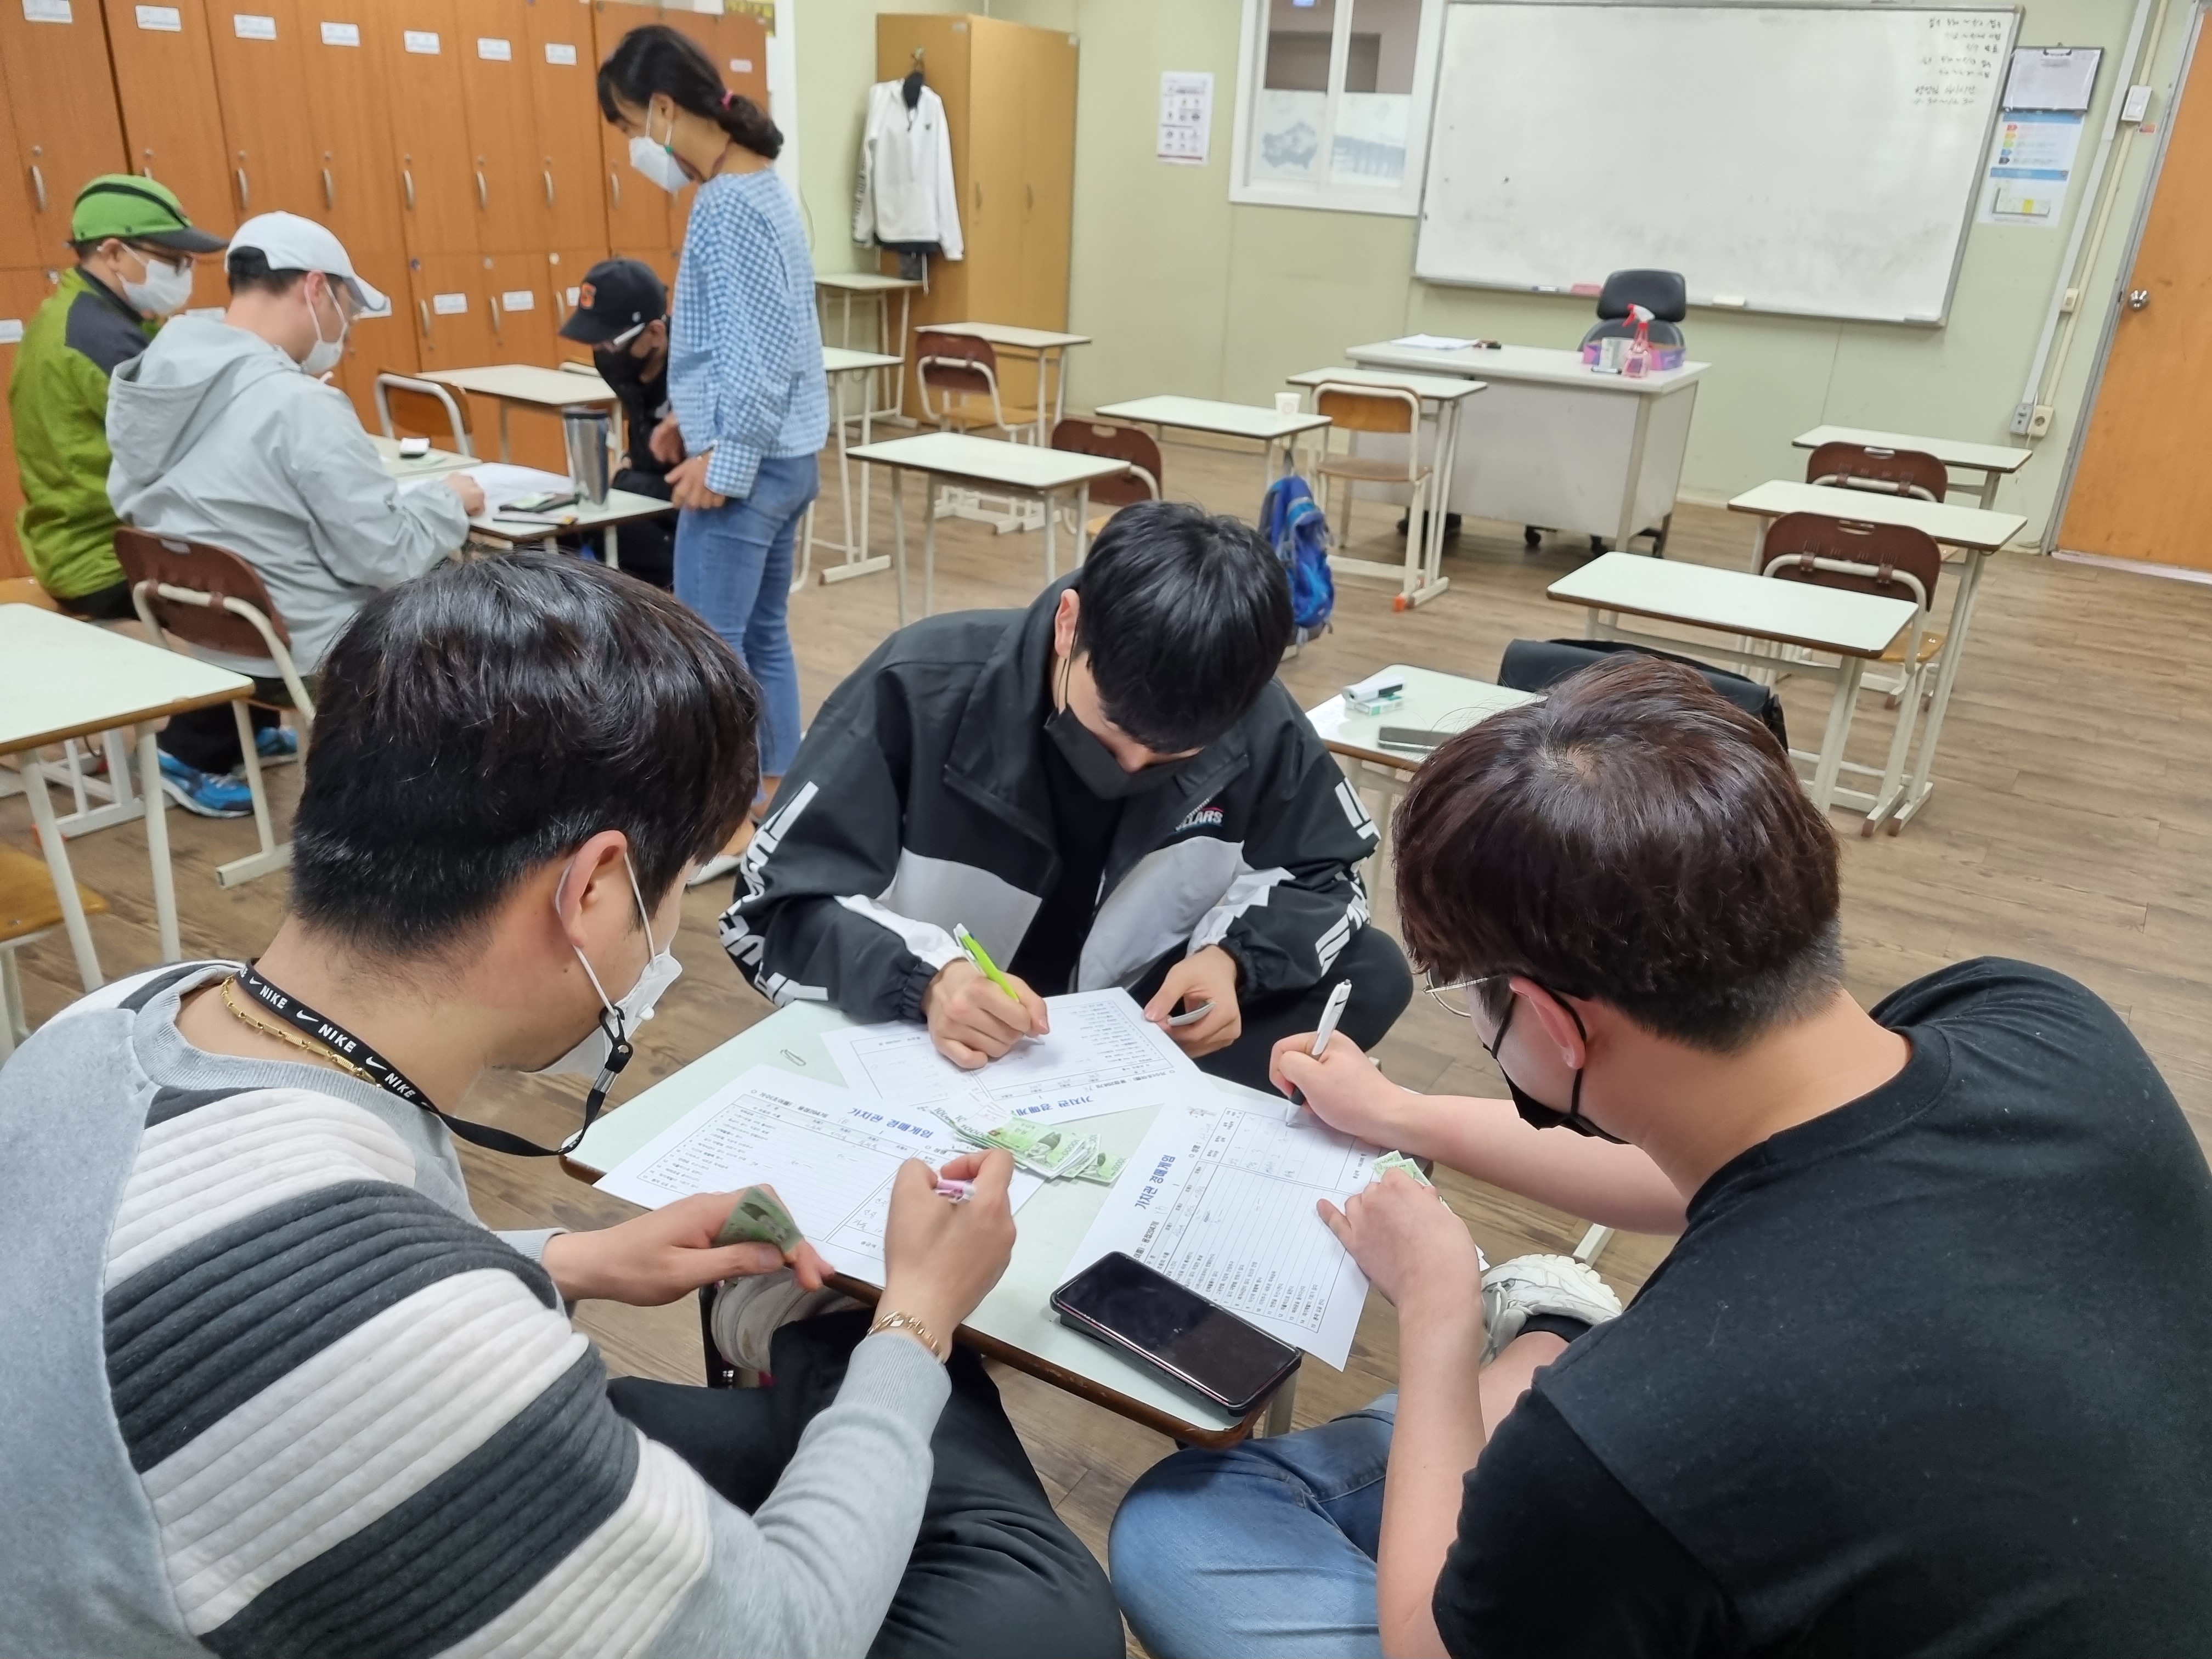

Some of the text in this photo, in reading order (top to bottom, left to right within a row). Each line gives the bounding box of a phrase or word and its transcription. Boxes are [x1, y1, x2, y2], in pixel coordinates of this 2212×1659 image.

[259, 985, 288, 1009] NIKE
[318, 1024, 357, 1053] NIKE
[385, 1073, 416, 1098] NIKE
[1015, 1096, 1093, 1116] 가치관 경매게
[848, 1107, 933, 1138] 가치관 경매게임
[961, 1124, 989, 1141] 10000
[1190, 1144, 1200, 1153] 성명
[1134, 1154, 1175, 1209] 가치관 경매게임
[1141, 1220, 1159, 1243] 용접204기
